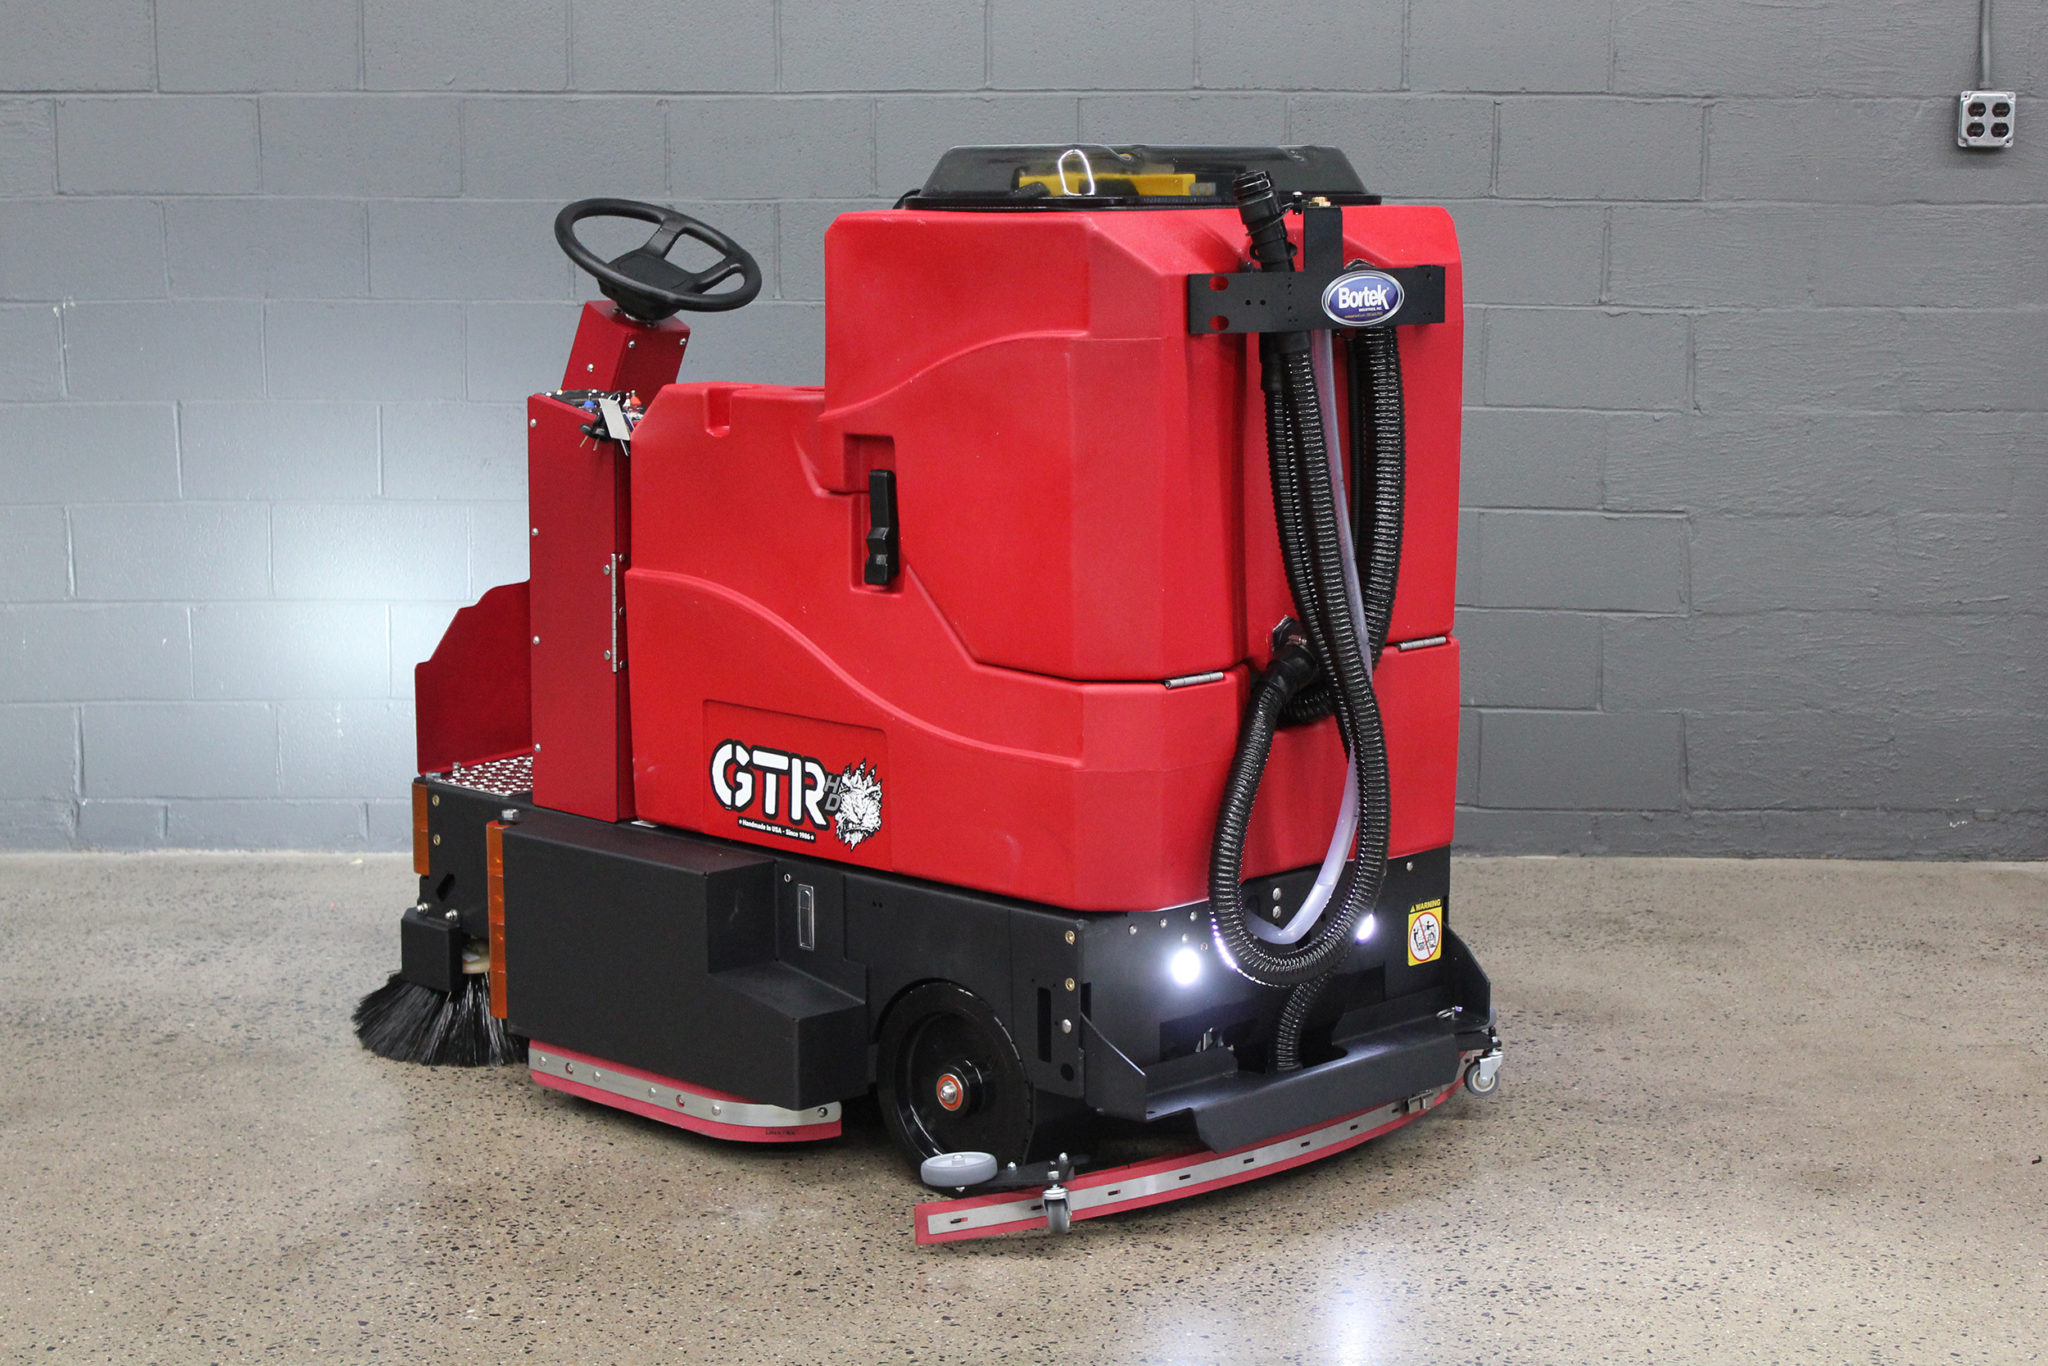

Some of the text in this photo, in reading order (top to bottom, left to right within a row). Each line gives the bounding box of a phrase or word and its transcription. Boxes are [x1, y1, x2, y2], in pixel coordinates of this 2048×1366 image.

[1338, 284, 1390, 310] Bortek
[711, 741, 828, 828] GTR
[742, 819, 766, 830] Handmade
[772, 825, 782, 834] USA
[785, 828, 799, 838] Since
[1415, 898, 1441, 911] WARNING
